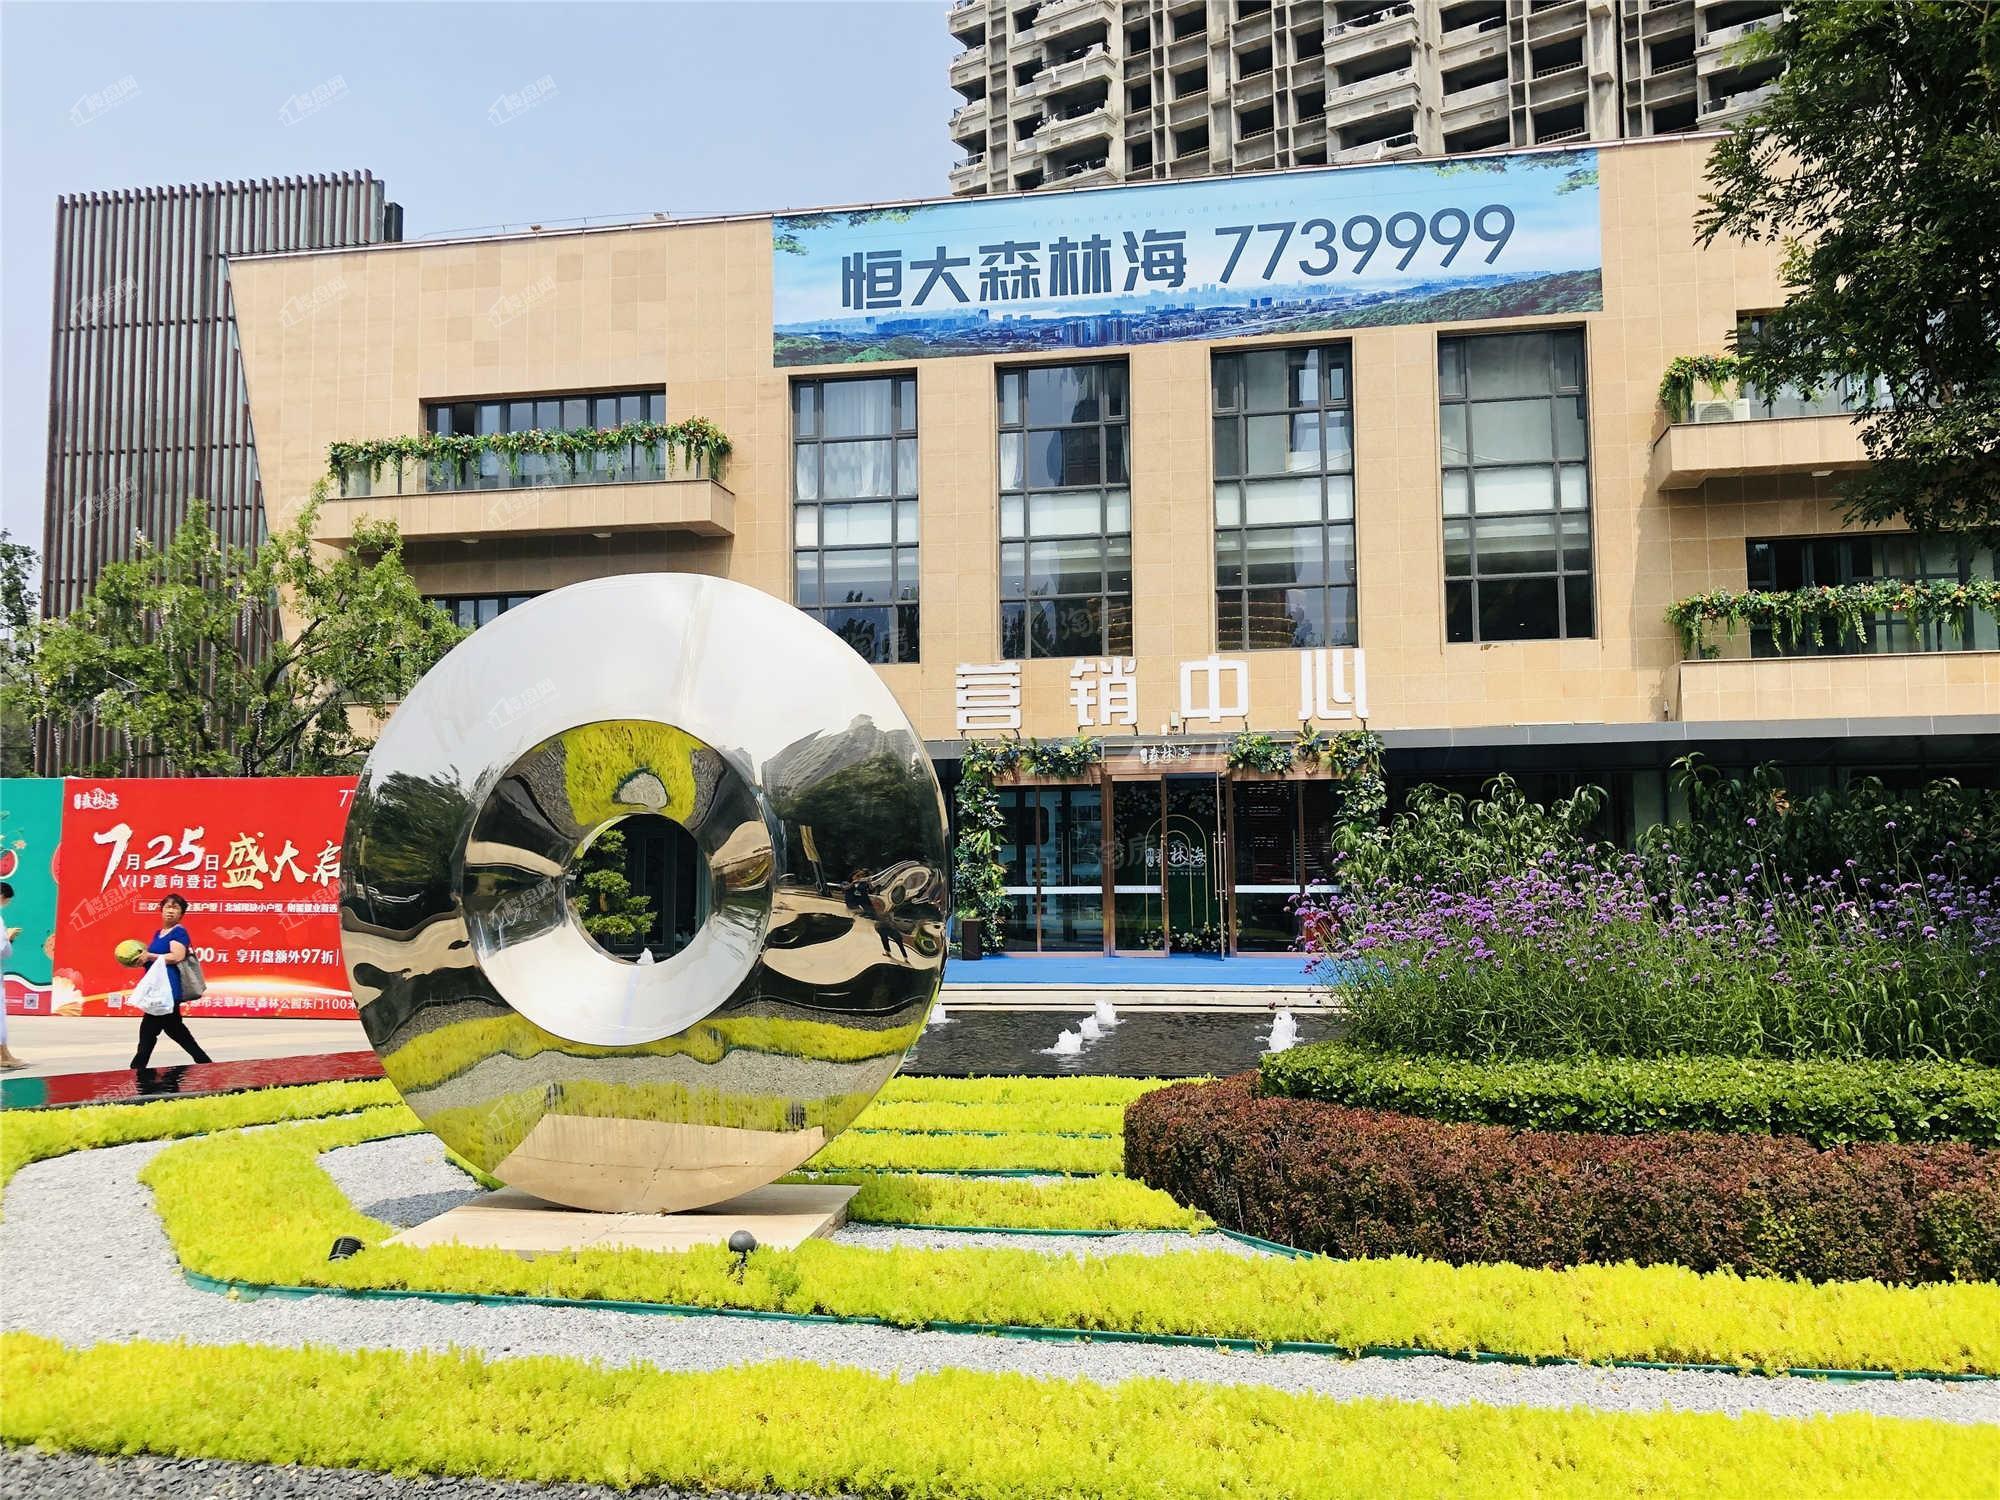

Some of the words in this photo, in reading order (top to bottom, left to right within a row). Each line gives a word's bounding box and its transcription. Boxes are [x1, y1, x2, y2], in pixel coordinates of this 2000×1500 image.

[841, 231, 1188, 310] 恒大森林海
[1215, 204, 1516, 282] 7739999
[955, 648, 1370, 731] 营销中心
[119, 874, 217, 889] VIP意向登记
[236, 948, 334, 964] 享开盘额外97折
